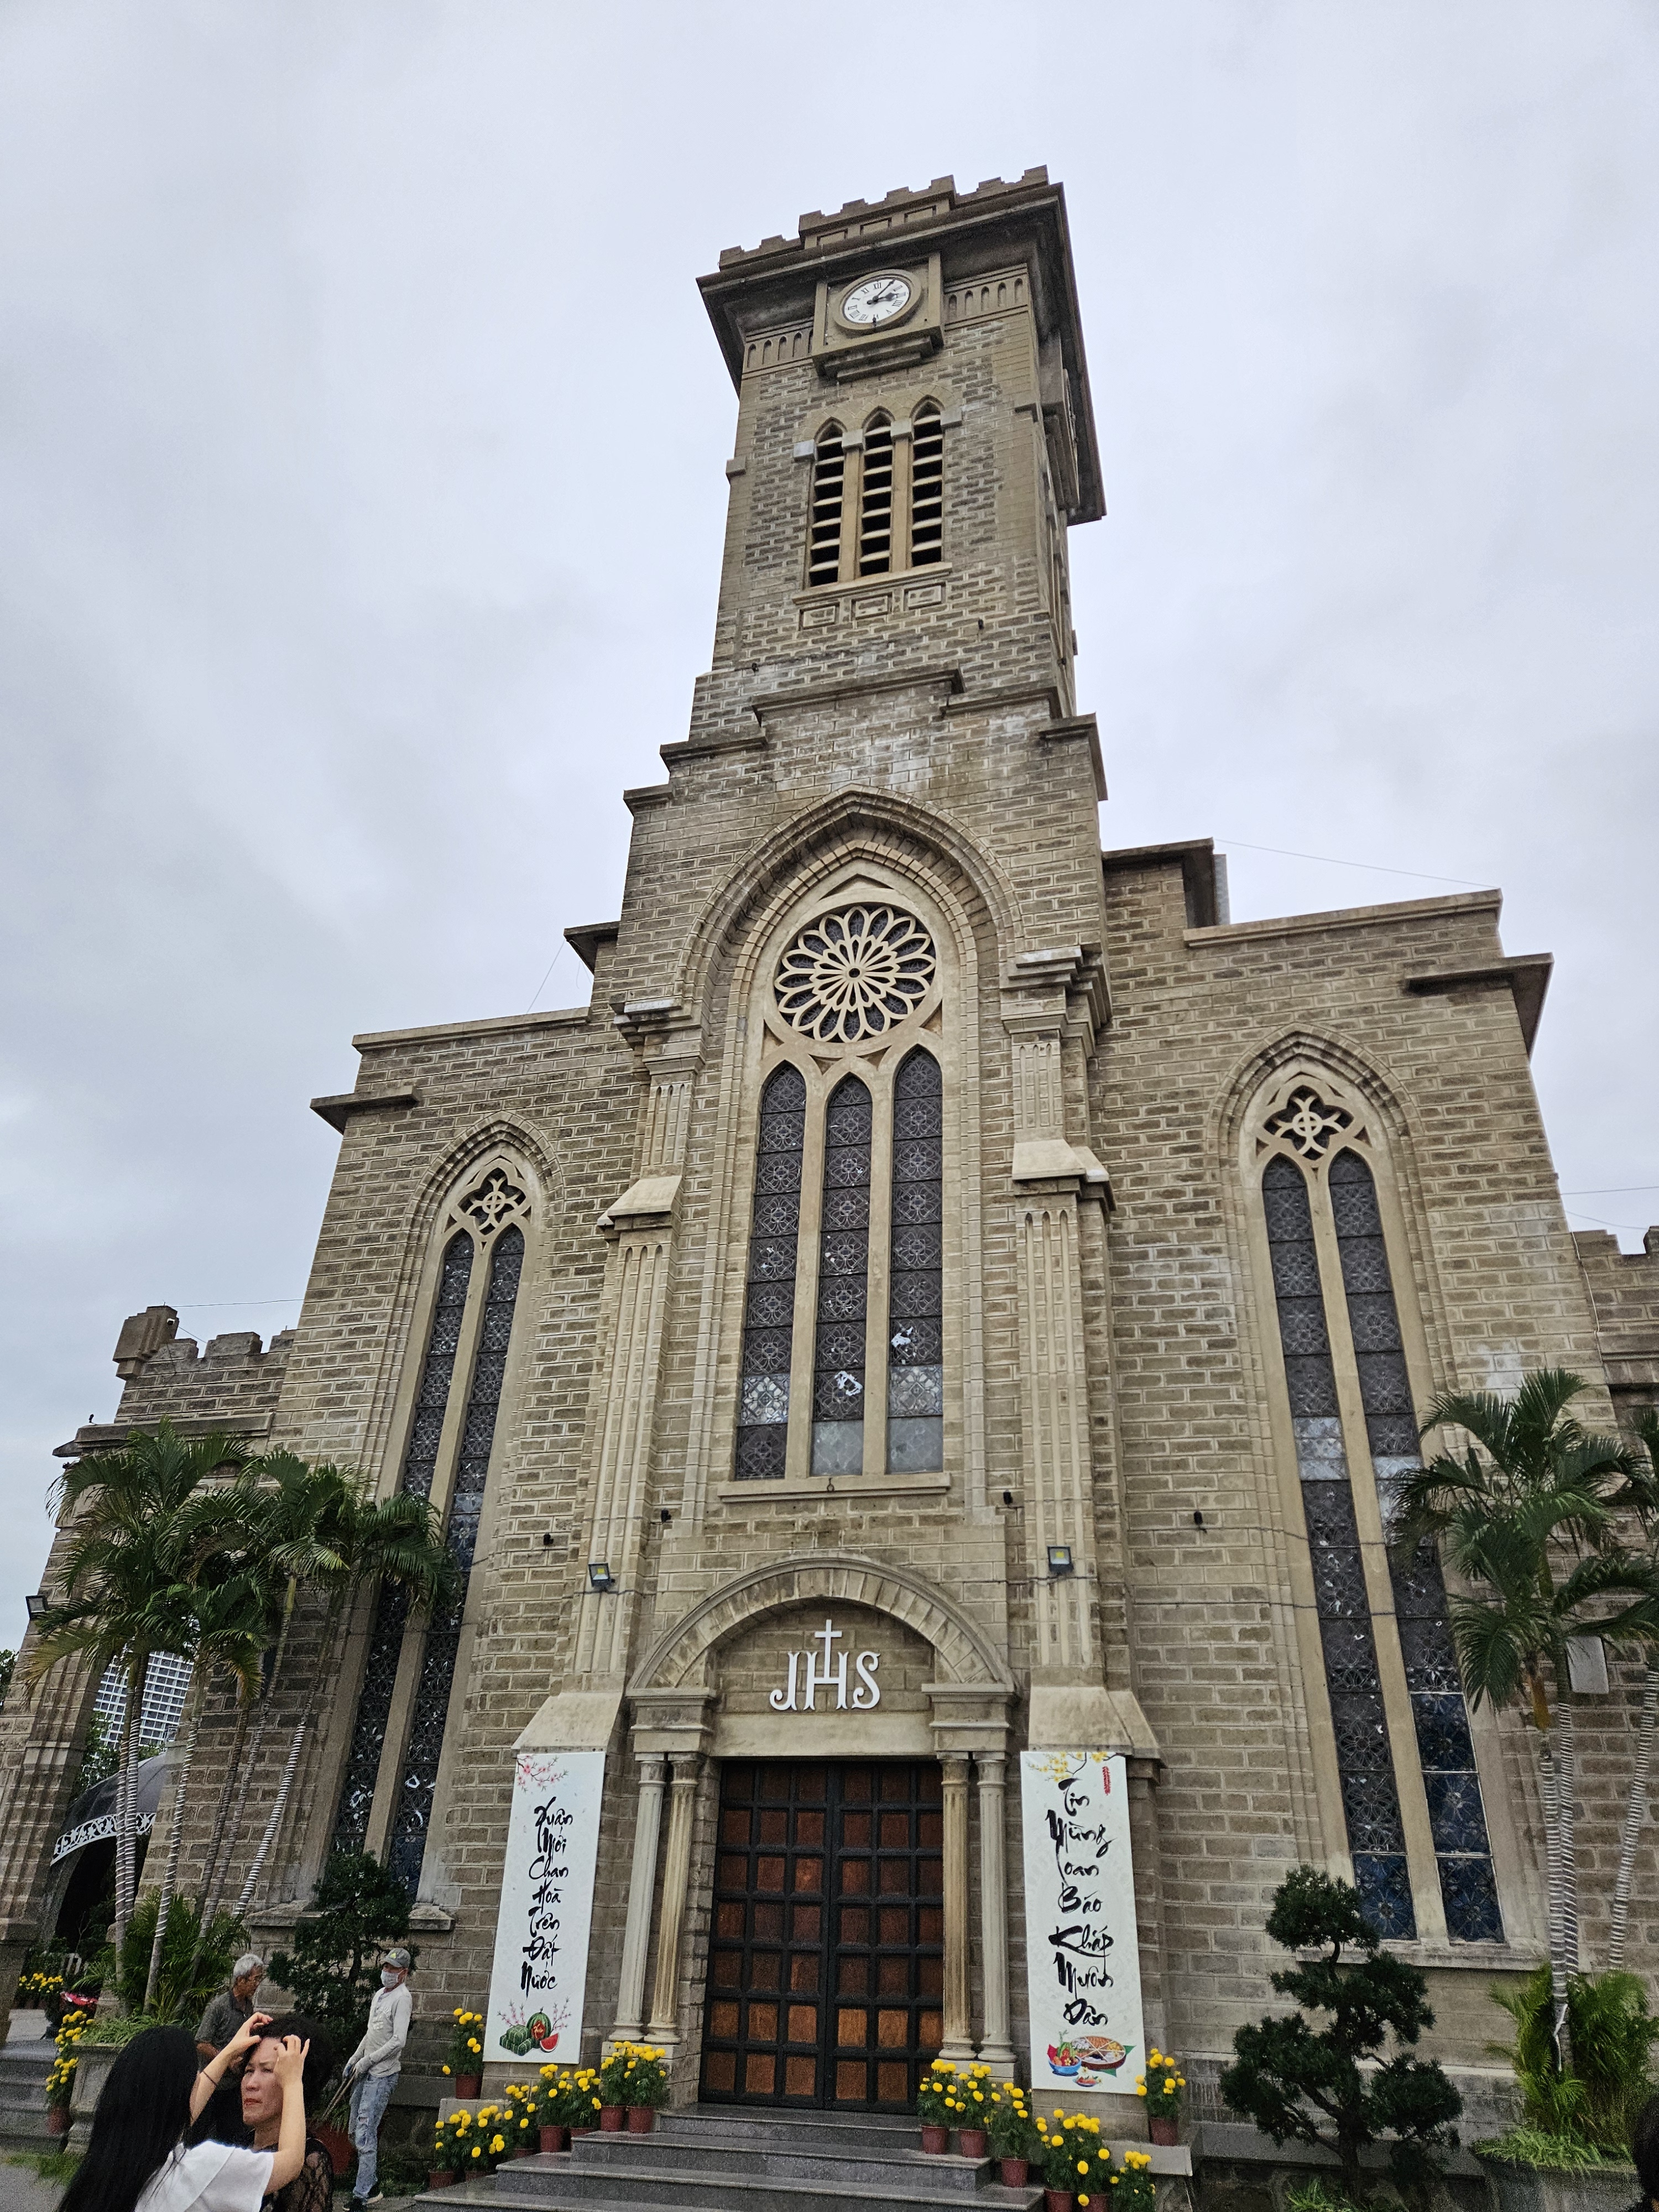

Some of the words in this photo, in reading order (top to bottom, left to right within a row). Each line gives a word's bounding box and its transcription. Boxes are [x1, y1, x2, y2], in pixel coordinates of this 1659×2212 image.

[1058, 1777, 1090, 1817] Tin
[534, 1797, 573, 1853] Xuân
[1045, 1809, 1117, 1858] Mừng
[541, 1826, 567, 1863] Mới
[529, 1855, 568, 1880] Chan
[532, 1878, 564, 1914] Hoà
[1058, 1882, 1103, 1914] Báo
[528, 1906, 560, 1938] Trên
[523, 1934, 562, 1966] Đất
[1048, 1924, 1114, 1974] Khắp
[520, 1961, 558, 2000] Nước
[1053, 1952, 1114, 2000] Muôn
[1063, 1998, 1108, 2026] Dân
